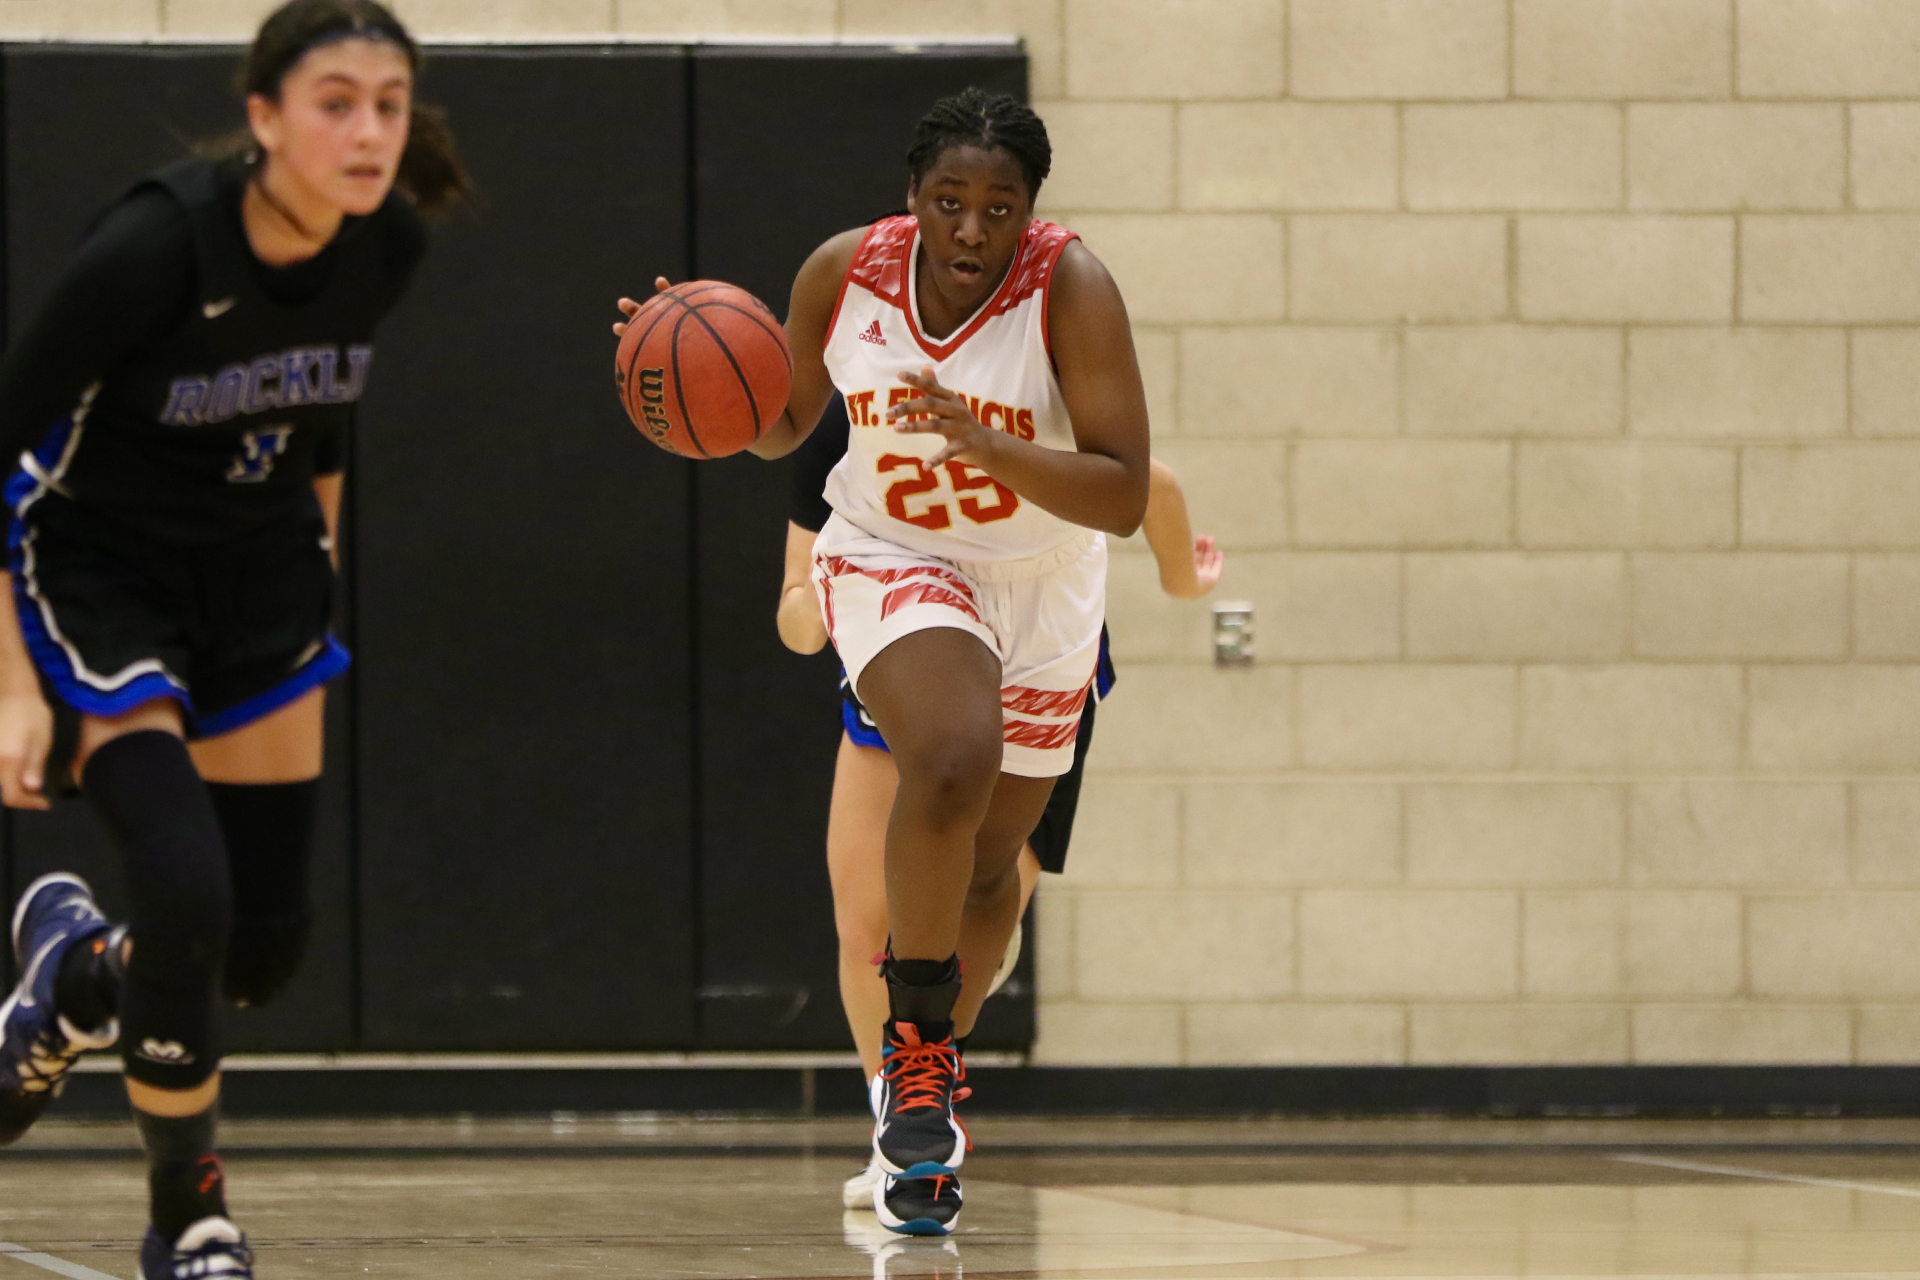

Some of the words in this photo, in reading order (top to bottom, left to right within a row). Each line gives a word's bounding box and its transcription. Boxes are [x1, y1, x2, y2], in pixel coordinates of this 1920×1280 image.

[859, 333, 887, 346] adidas
[158, 345, 374, 427] ROCKLI
[639, 367, 680, 453] Wilso
[847, 390, 881, 428] ST.
[886, 386, 1036, 443] FRNCIS
[876, 452, 1021, 531] 25
